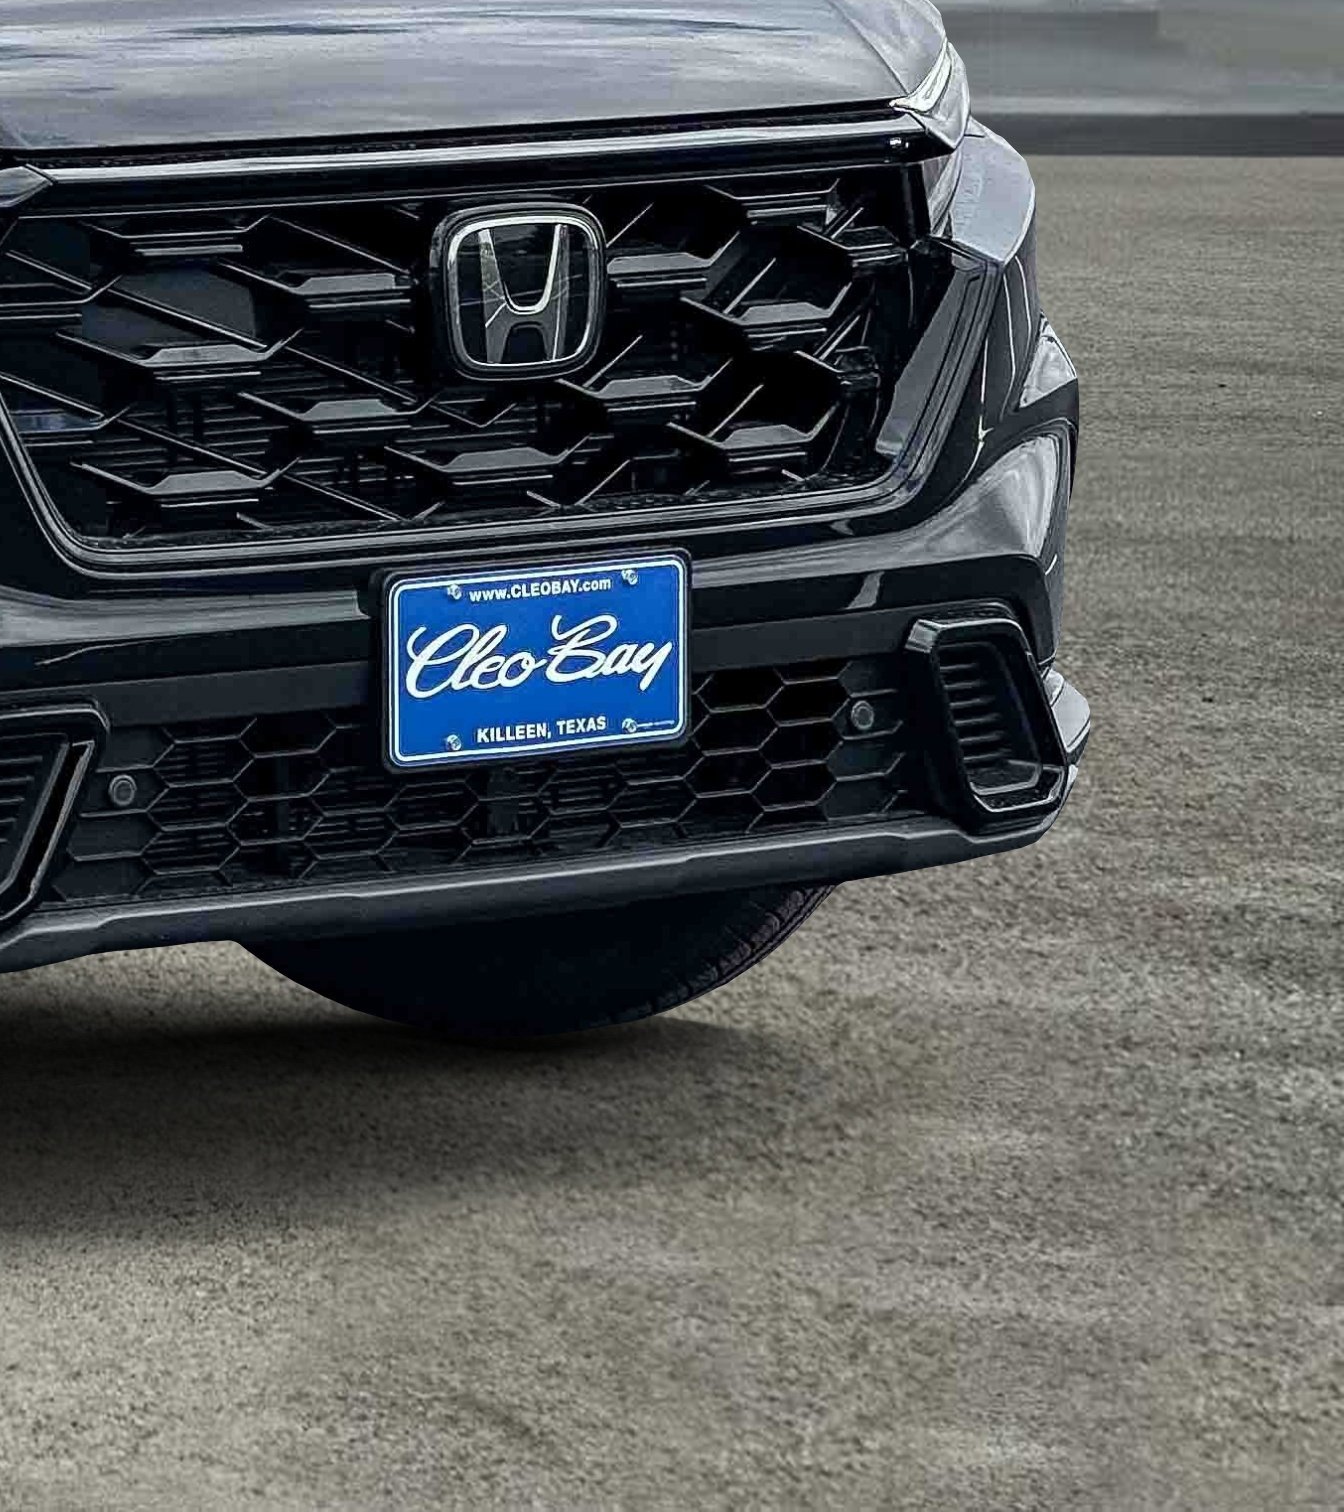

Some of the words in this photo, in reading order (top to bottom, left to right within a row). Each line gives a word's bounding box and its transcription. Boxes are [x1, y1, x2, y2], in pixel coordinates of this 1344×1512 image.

[468, 577, 612, 602] www.CLEOBAY.com
[406, 623, 547, 699] Cleo
[546, 614, 673, 691] Bay
[477, 723, 551, 744] KILLEEN,
[556, 716, 607, 735] TEXAS
